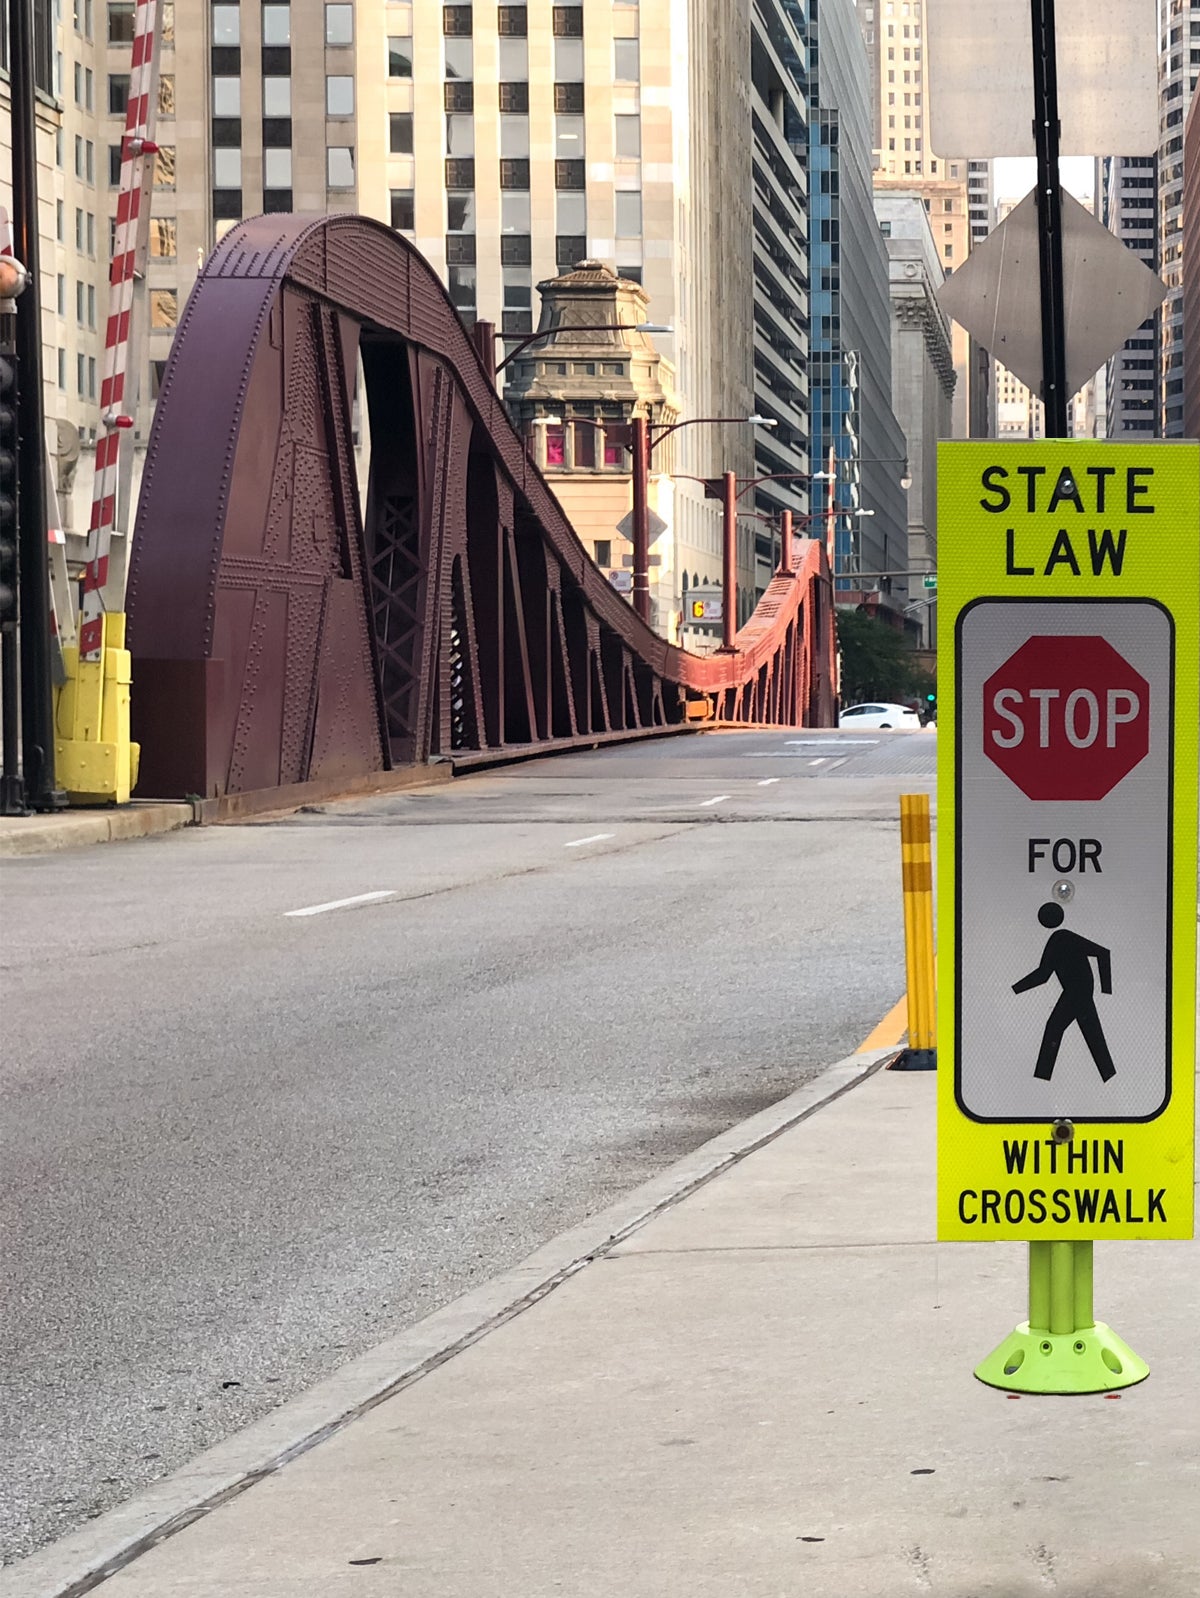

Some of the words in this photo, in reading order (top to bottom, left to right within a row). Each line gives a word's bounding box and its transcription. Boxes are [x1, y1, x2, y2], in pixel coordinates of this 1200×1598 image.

[979, 465, 1155, 514] STATE
[1005, 528, 1128, 577] LAW
[991, 688, 1141, 749] STOP
[1028, 838, 1103, 874] FOR
[1002, 1139, 1124, 1175] WITHIN
[958, 1188, 1168, 1225] CROSSWALK
